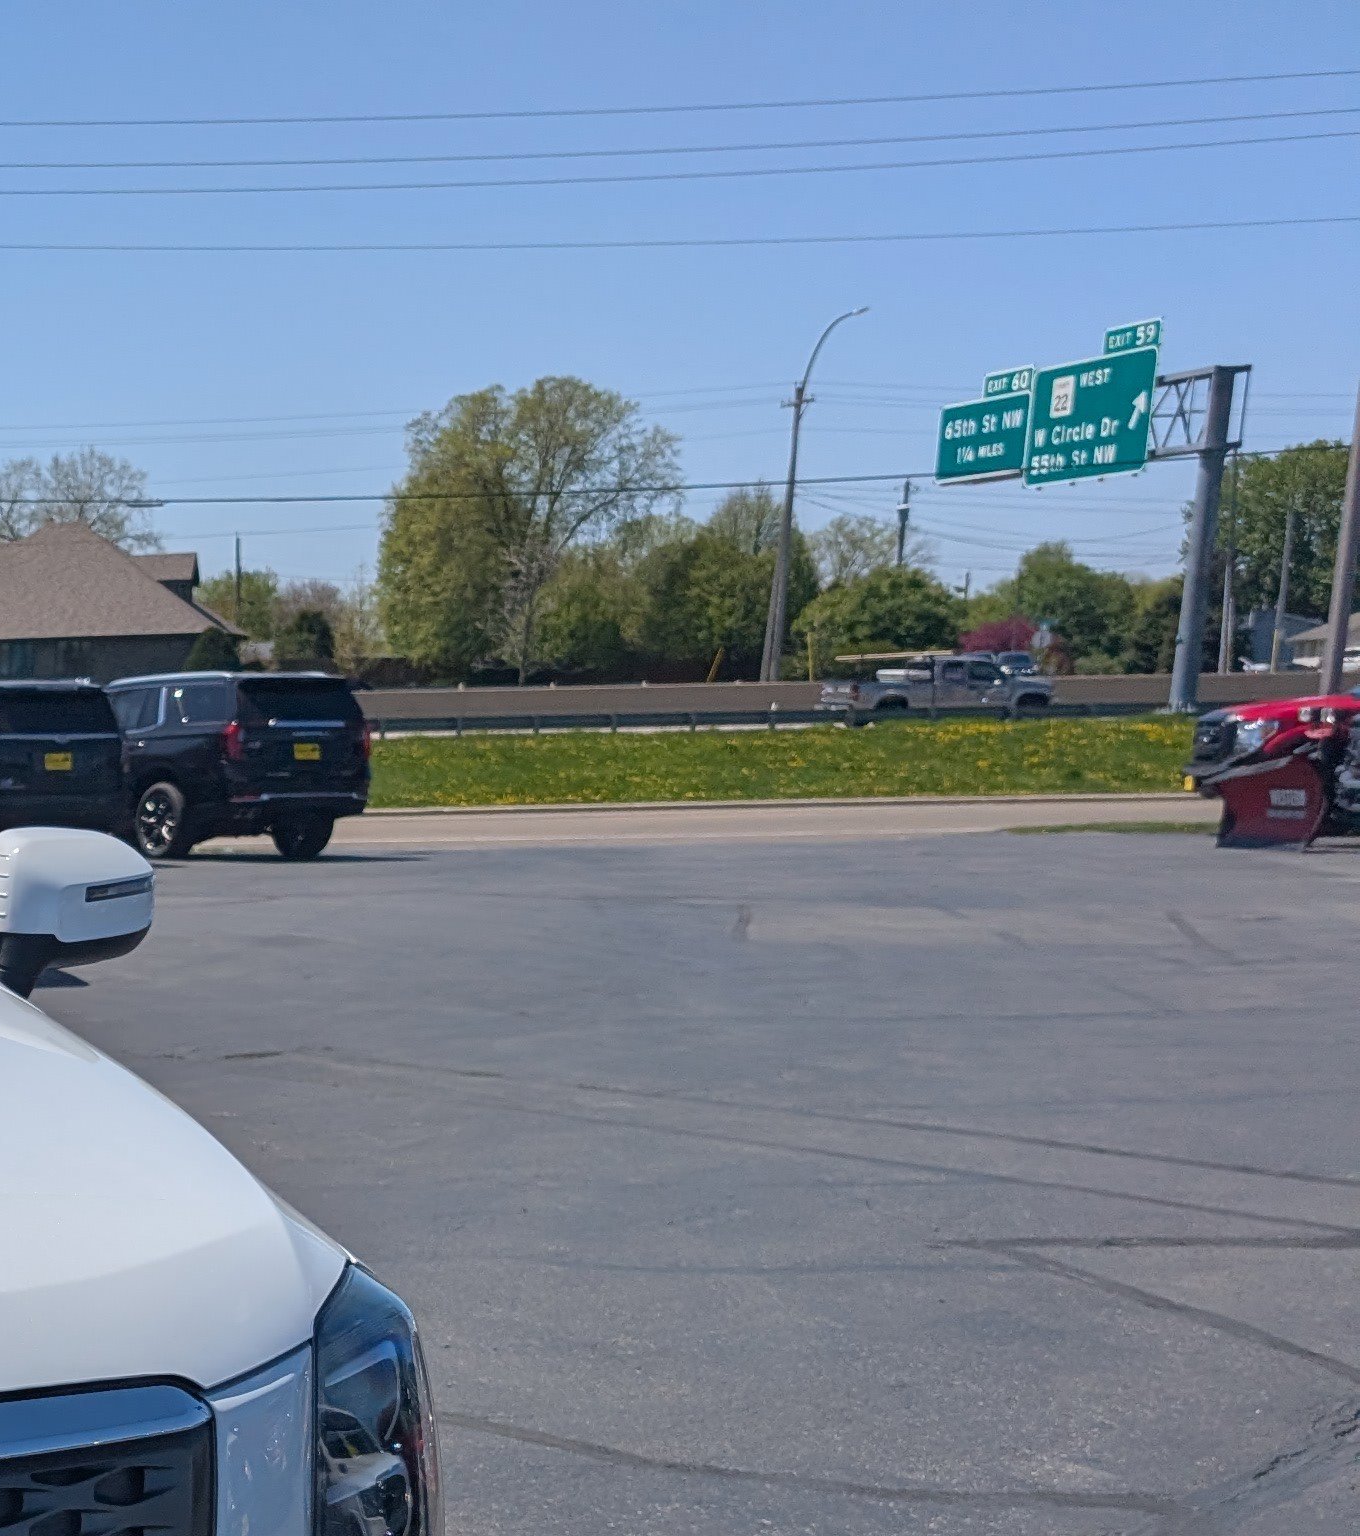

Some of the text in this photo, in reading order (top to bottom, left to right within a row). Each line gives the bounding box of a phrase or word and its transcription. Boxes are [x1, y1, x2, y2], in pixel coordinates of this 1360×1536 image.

[1109, 324, 1156, 348] EXIT 59
[988, 371, 1029, 393] EXIT 60
[1080, 368, 1111, 387] WEST
[1053, 394, 1069, 412] 22
[945, 408, 1024, 440] 65th St NW
[1035, 417, 1119, 448] W Circle Dr
[978, 442, 1005, 458] MILES
[1030, 443, 1117, 475] 55th St NW
